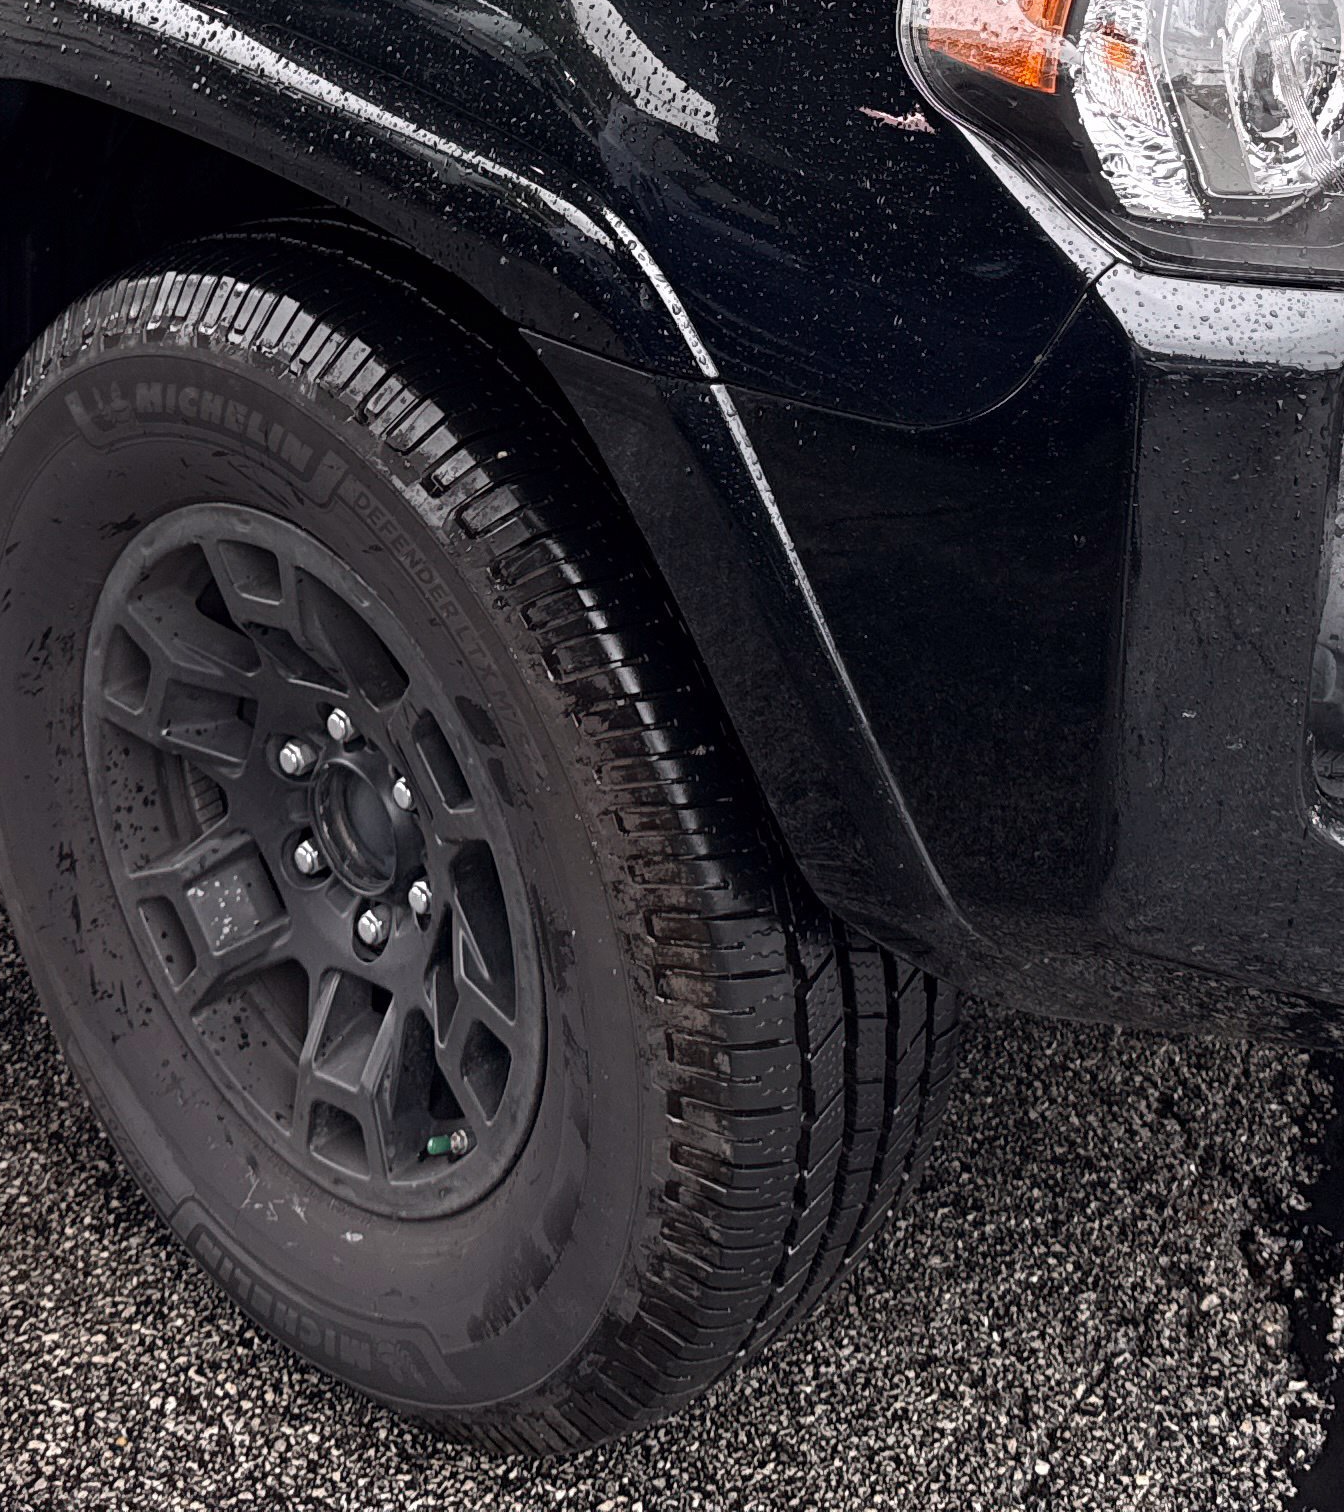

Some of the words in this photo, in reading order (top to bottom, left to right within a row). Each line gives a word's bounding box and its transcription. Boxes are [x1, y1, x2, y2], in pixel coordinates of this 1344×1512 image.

[135, 381, 315, 473] MICHELIN
[353, 490, 460, 620] DEFENDER
[455, 624, 500, 682] LTX
[195, 1232, 372, 1372] MICHELIN
